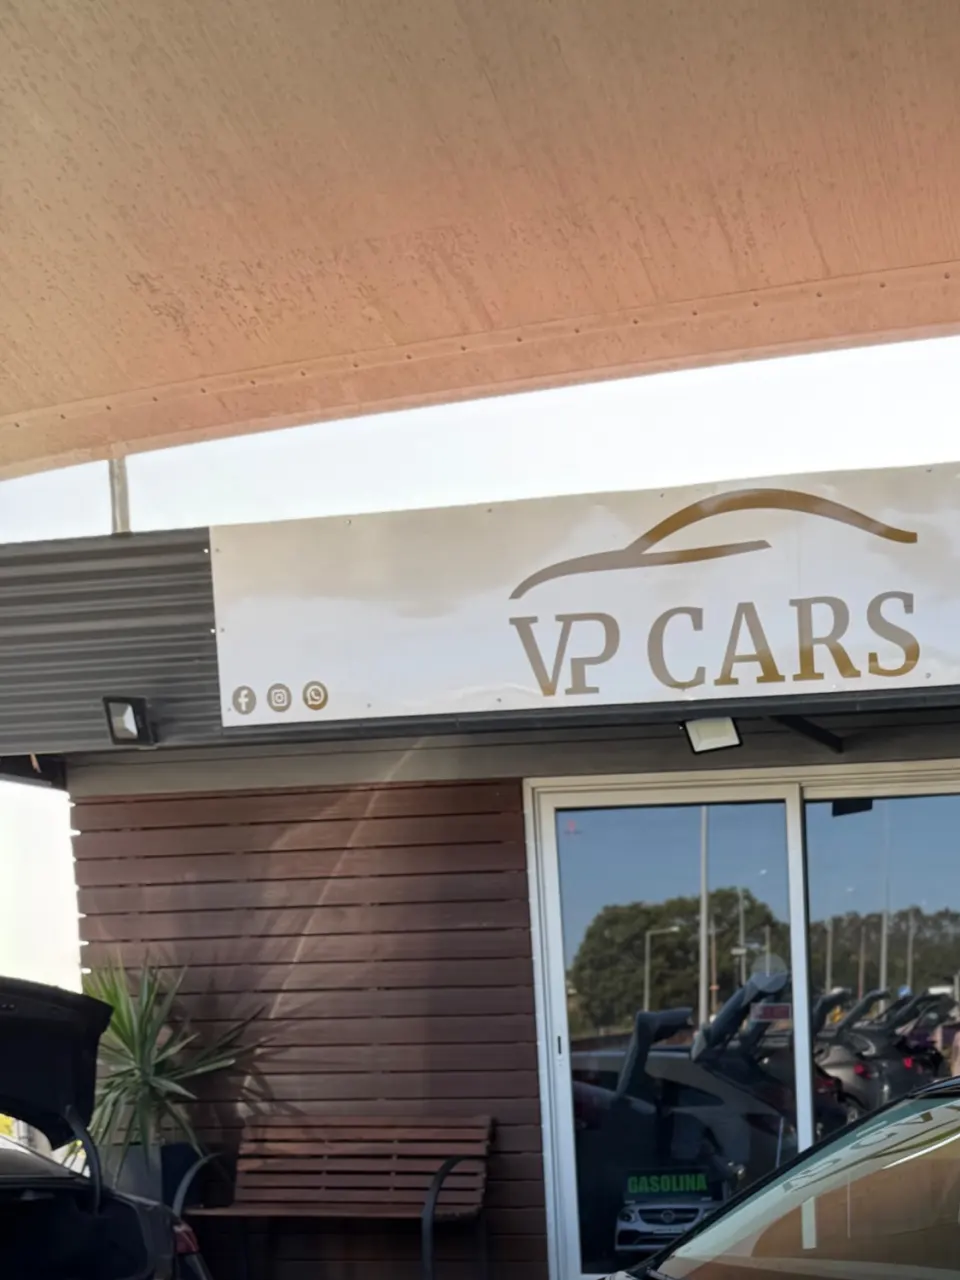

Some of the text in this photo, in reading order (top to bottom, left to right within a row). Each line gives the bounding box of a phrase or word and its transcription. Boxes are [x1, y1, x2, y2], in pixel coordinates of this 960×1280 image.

[508, 590, 921, 697] VP CARS
[627, 1173, 708, 1194] GASOLINA
